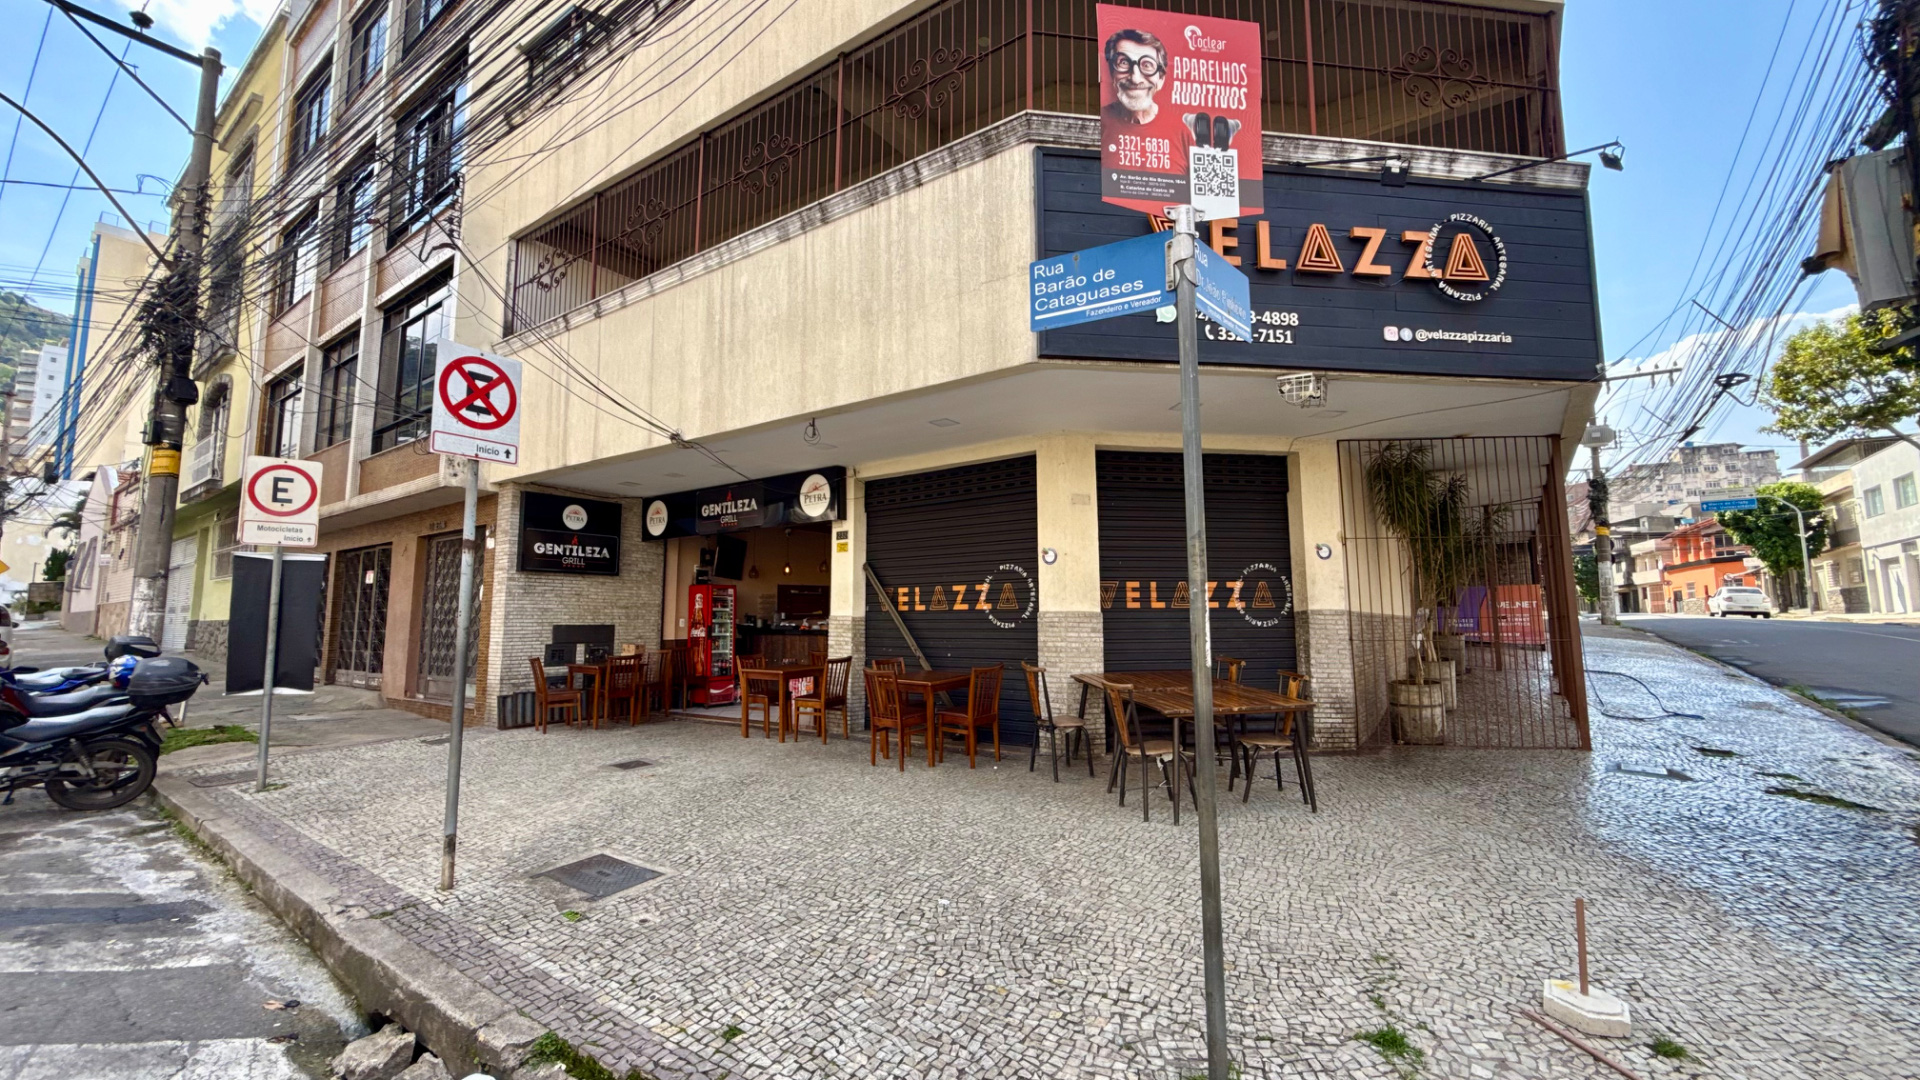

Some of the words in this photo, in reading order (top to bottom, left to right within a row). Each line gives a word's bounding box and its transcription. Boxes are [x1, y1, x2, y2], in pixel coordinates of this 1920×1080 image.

[1193, 34, 1227, 50] Coclear
[1173, 56, 1248, 86] APARELHOS
[1171, 81, 1248, 110] AUDITIVOS
[1118, 135, 1170, 154] 3321-6830
[1118, 151, 1171, 169] 3215-2676
[1148, 212, 1491, 281] ELAZZA
[1194, 242, 1208, 268] Rua
[1425, 223, 1442, 278] ARTESANAL
[1450, 213, 1493, 234] PIZZARIA
[1490, 236, 1508, 291] ARTESANAL
[1034, 263, 1064, 280] Rua
[1034, 274, 1087, 296] Barão
[1092, 268, 1116, 284] de
[1438, 280, 1482, 301] PIZZARIA
[1034, 279, 1144, 312] Cataguases
[1086, 303, 1123, 317] Fazendeiro
[1131, 295, 1161, 309] Vereador
[1217, 326, 1293, 344] 33-7151
[1415, 329, 1512, 343] @velazzapizzaria
[476, 444, 500, 456] Início
[271, 476, 294, 504] E
[804, 492, 827, 505] PETRA
[701, 498, 758, 517] GENTILEZA
[566, 514, 584, 523] PETRA
[649, 516, 666, 525] PETRA
[720, 515, 738, 524] GRILL
[257, 525, 303, 533] Motocicletas
[534, 542, 610, 558] GENTILEZA
[562, 556, 586, 566] GRILL
[999, 563, 1027, 578] PIZZARIA
